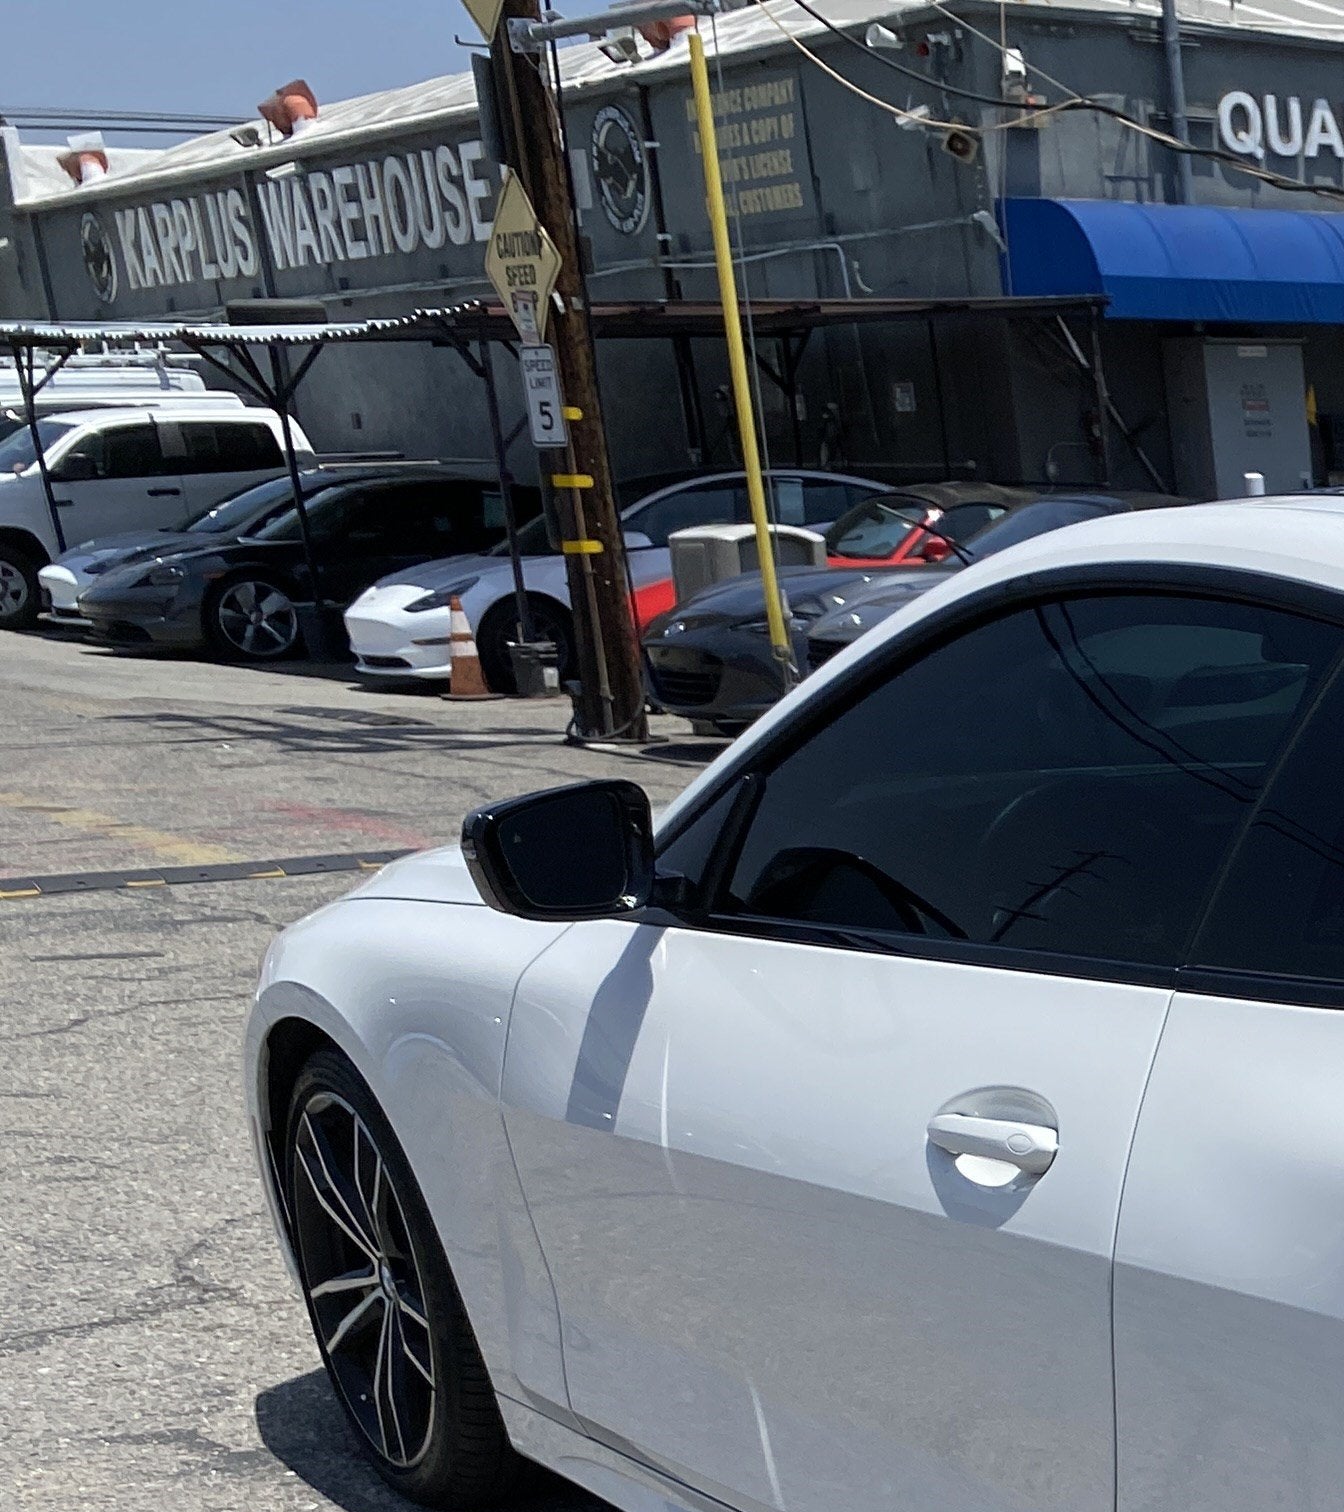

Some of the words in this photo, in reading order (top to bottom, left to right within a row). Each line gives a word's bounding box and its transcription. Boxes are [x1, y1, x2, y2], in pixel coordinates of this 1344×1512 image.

[751, 116, 779, 144] COPY
[114, 187, 261, 290] KARPLUS
[257, 139, 494, 271] WAREHOUSE
[505, 263, 537, 287] SPEED
[524, 359, 553, 372] SPEED
[529, 376, 552, 390] LIMIT
[539, 401, 554, 431] 5
